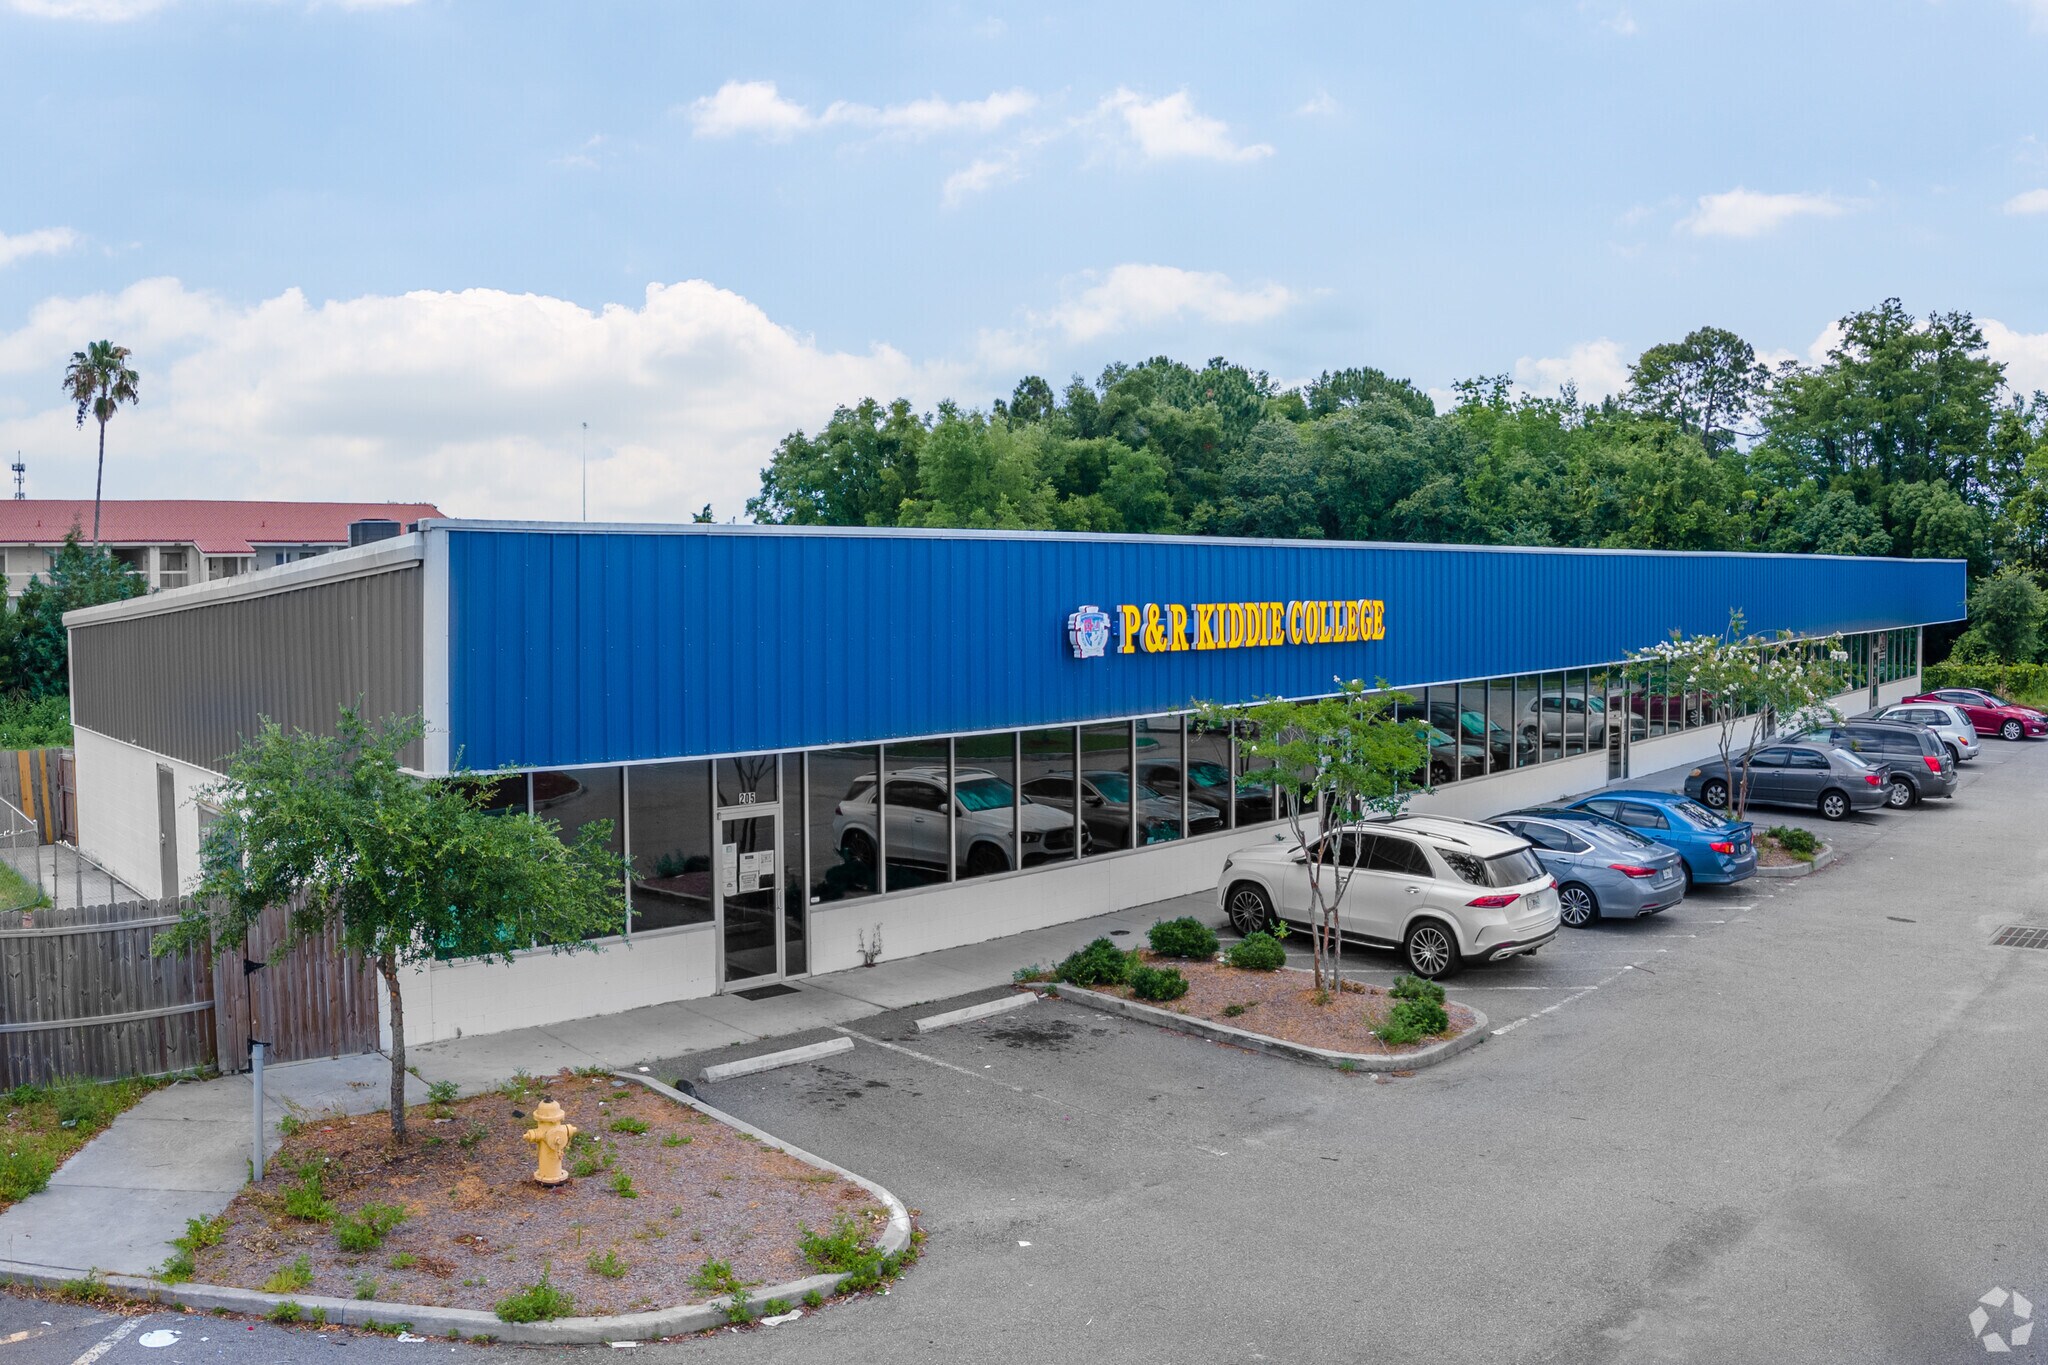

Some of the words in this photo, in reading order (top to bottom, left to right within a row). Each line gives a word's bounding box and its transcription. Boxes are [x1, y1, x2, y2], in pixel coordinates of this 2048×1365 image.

[1117, 603, 1189, 653] P&R
[1191, 602, 1285, 650] KIDDIE
[1286, 599, 1385, 645] COLLEGE
[739, 792, 755, 804] 205
